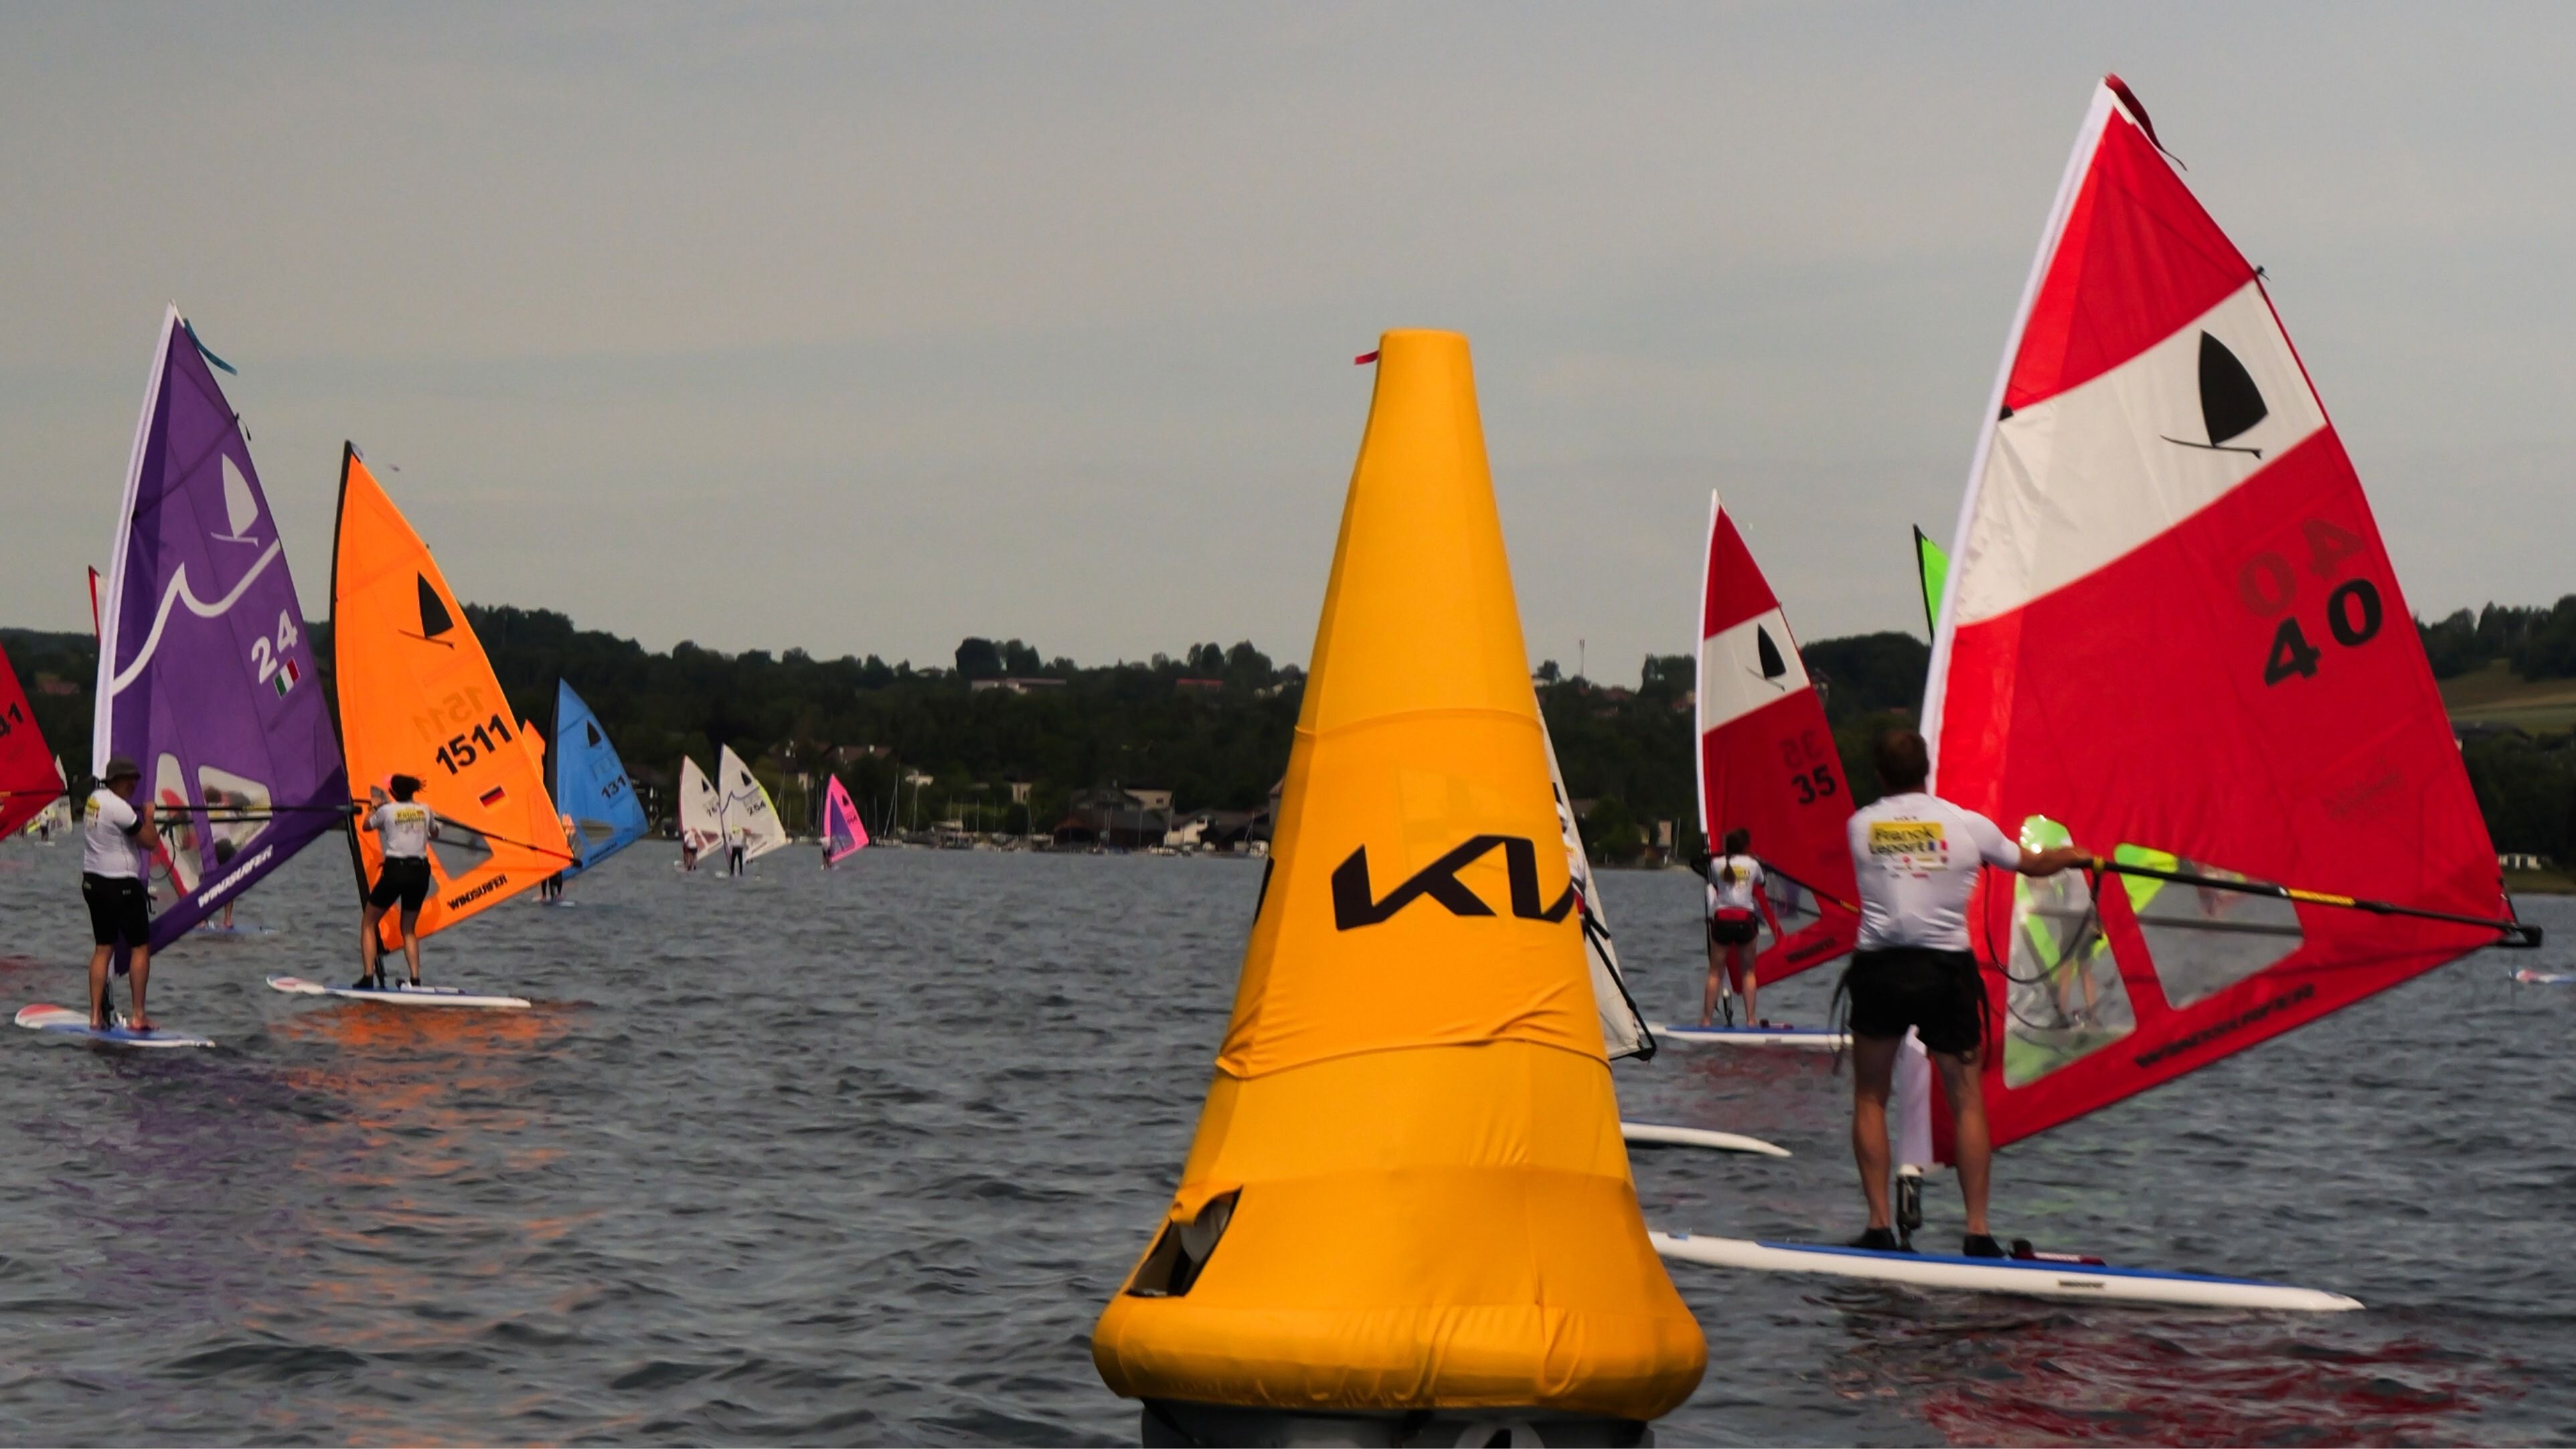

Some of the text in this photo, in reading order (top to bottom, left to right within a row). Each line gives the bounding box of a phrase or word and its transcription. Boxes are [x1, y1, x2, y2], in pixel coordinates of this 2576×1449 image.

[251, 608, 298, 685] 24
[2263, 578, 2383, 687] 40
[436, 713, 513, 776] 1511
[601, 774, 626, 799] 131
[1791, 764, 1836, 805] 35
[198, 844, 273, 909] WINDSURFER
[447, 873, 508, 911] WINDSURFER
